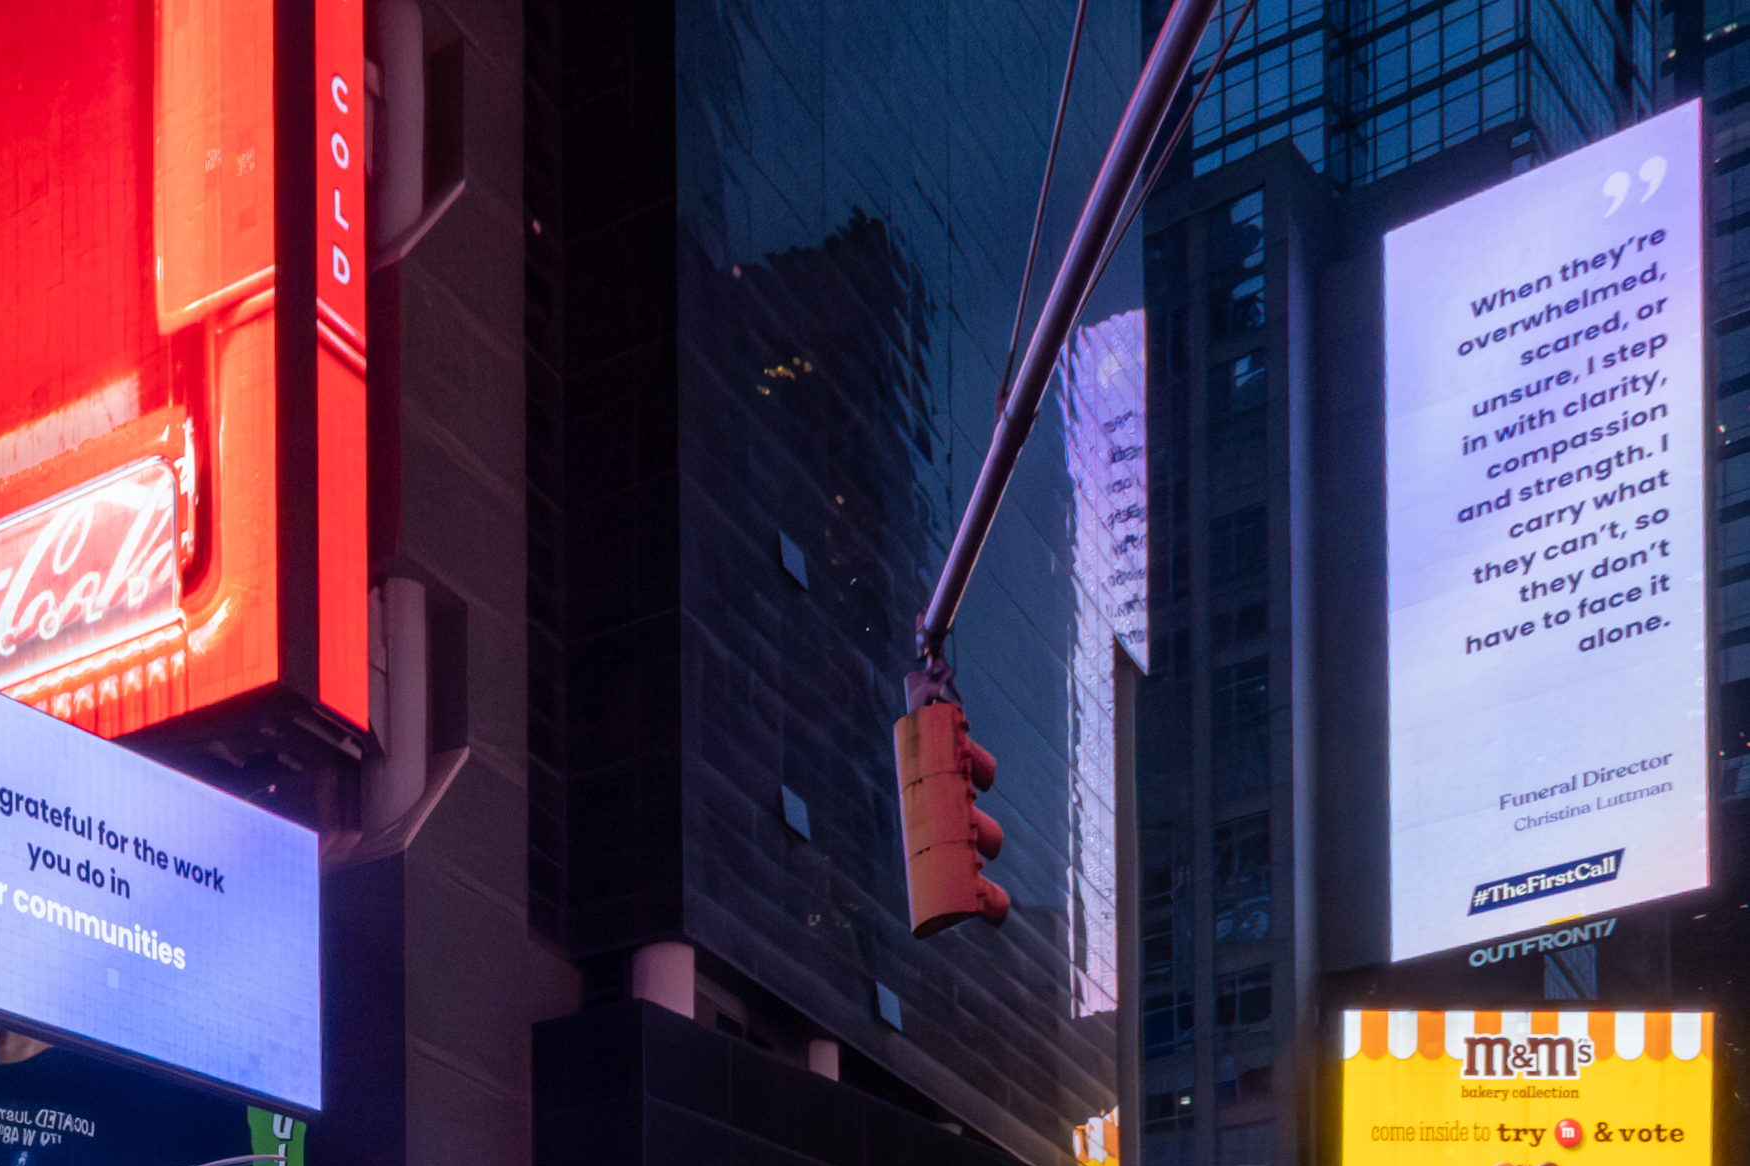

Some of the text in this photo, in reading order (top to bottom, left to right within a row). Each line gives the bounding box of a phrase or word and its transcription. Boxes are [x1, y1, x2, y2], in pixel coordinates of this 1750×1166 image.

[331, 75, 350, 285] COLD
[1457, 262, 1668, 356] overwhelmed,
[1470, 227, 1668, 318] When they're
[1520, 296, 1668, 366] scared, or
[1462, 369, 1668, 456] in with clarity,
[1472, 332, 1668, 418] unsure, I step
[1457, 433, 1669, 524] and strength. I
[1486, 402, 1668, 479] compassion
[1508, 469, 1670, 539] carry what
[1472, 508, 1670, 585] they can't, so
[1518, 539, 1671, 603] they don't
[1465, 573, 1671, 655] have to face it
[1577, 614, 1671, 653] alone.
[1499, 752, 1674, 810] Funeral Director
[1514, 781, 1674, 831] Christina Luttman
[0, 786, 92, 841] grateful
[98, 820, 129, 853] for
[133, 836, 169, 870] the
[173, 856, 226, 894] work
[27, 841, 130, 899] you do in
[1472, 856, 1616, 908] #TheFirstCall
[13, 888, 186, 970] communities
[1461, 1086, 1580, 1101] bakery collection
[1371, 1124, 1415, 1142] come
[1419, 1121, 1469, 1142] inside
[1473, 1123, 1491, 1142] to
[1497, 1123, 1546, 1147] try
[1594, 1122, 1613, 1142] &
[1618, 1123, 1684, 1142] vote
